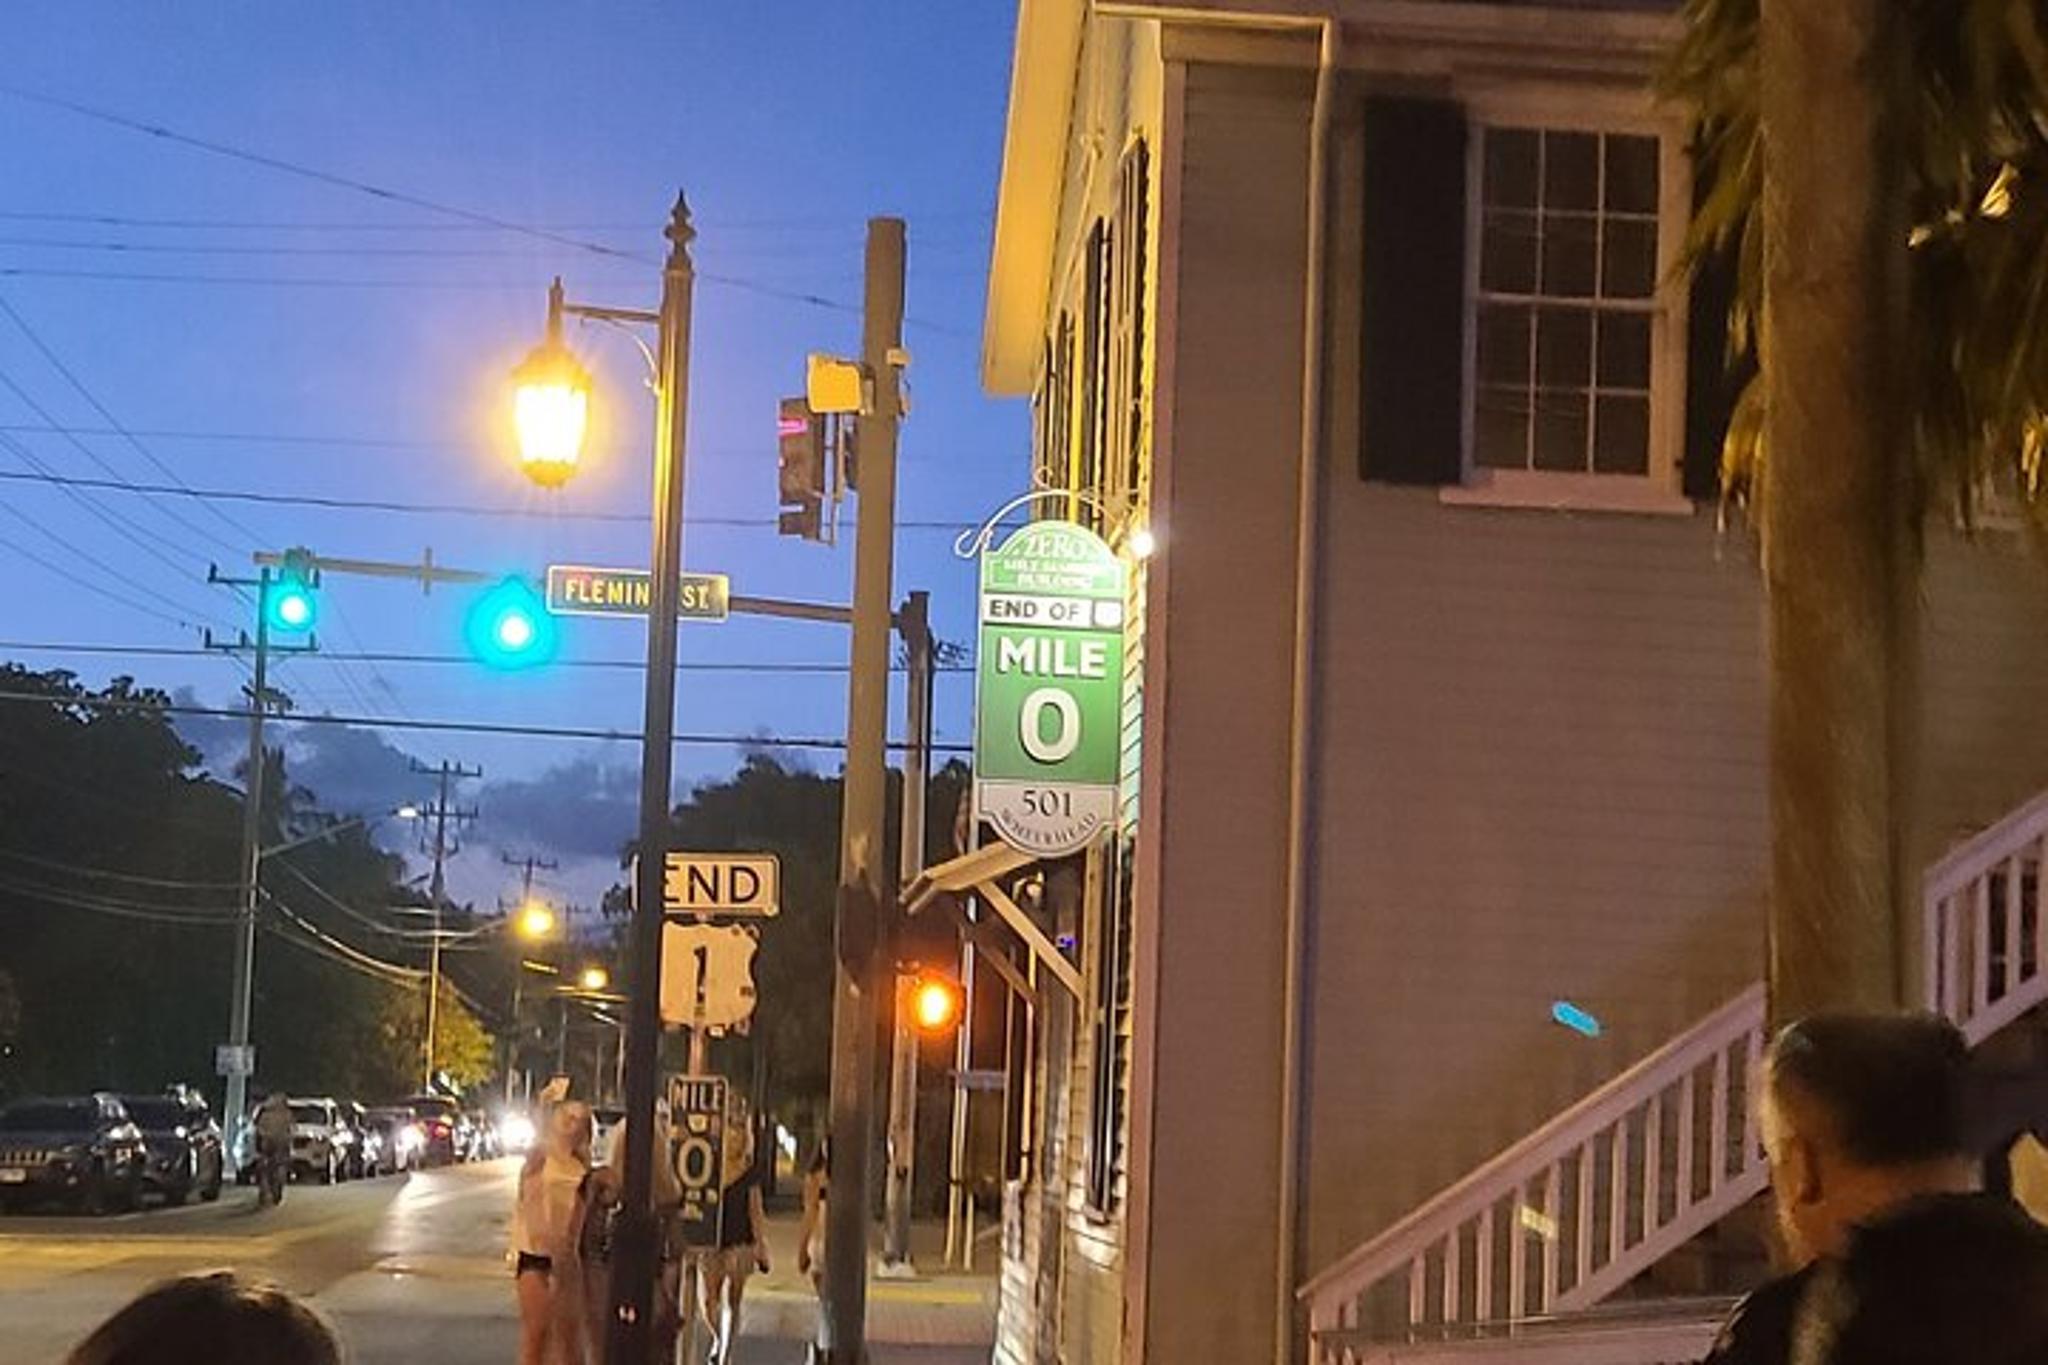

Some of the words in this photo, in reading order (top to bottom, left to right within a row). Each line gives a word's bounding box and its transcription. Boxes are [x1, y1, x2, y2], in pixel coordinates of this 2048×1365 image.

[1023, 533, 1088, 559] ZERO
[565, 578, 650, 607] FLEMIN
[990, 600, 1038, 618] END
[1050, 602, 1080, 621] OF
[998, 635, 1107, 680] MILE
[1020, 686, 1080, 765] 0
[1022, 789, 1071, 818] 501
[693, 945, 707, 1004] 1
[673, 1083, 723, 1112] MILE
[677, 1136, 714, 1188] 0
